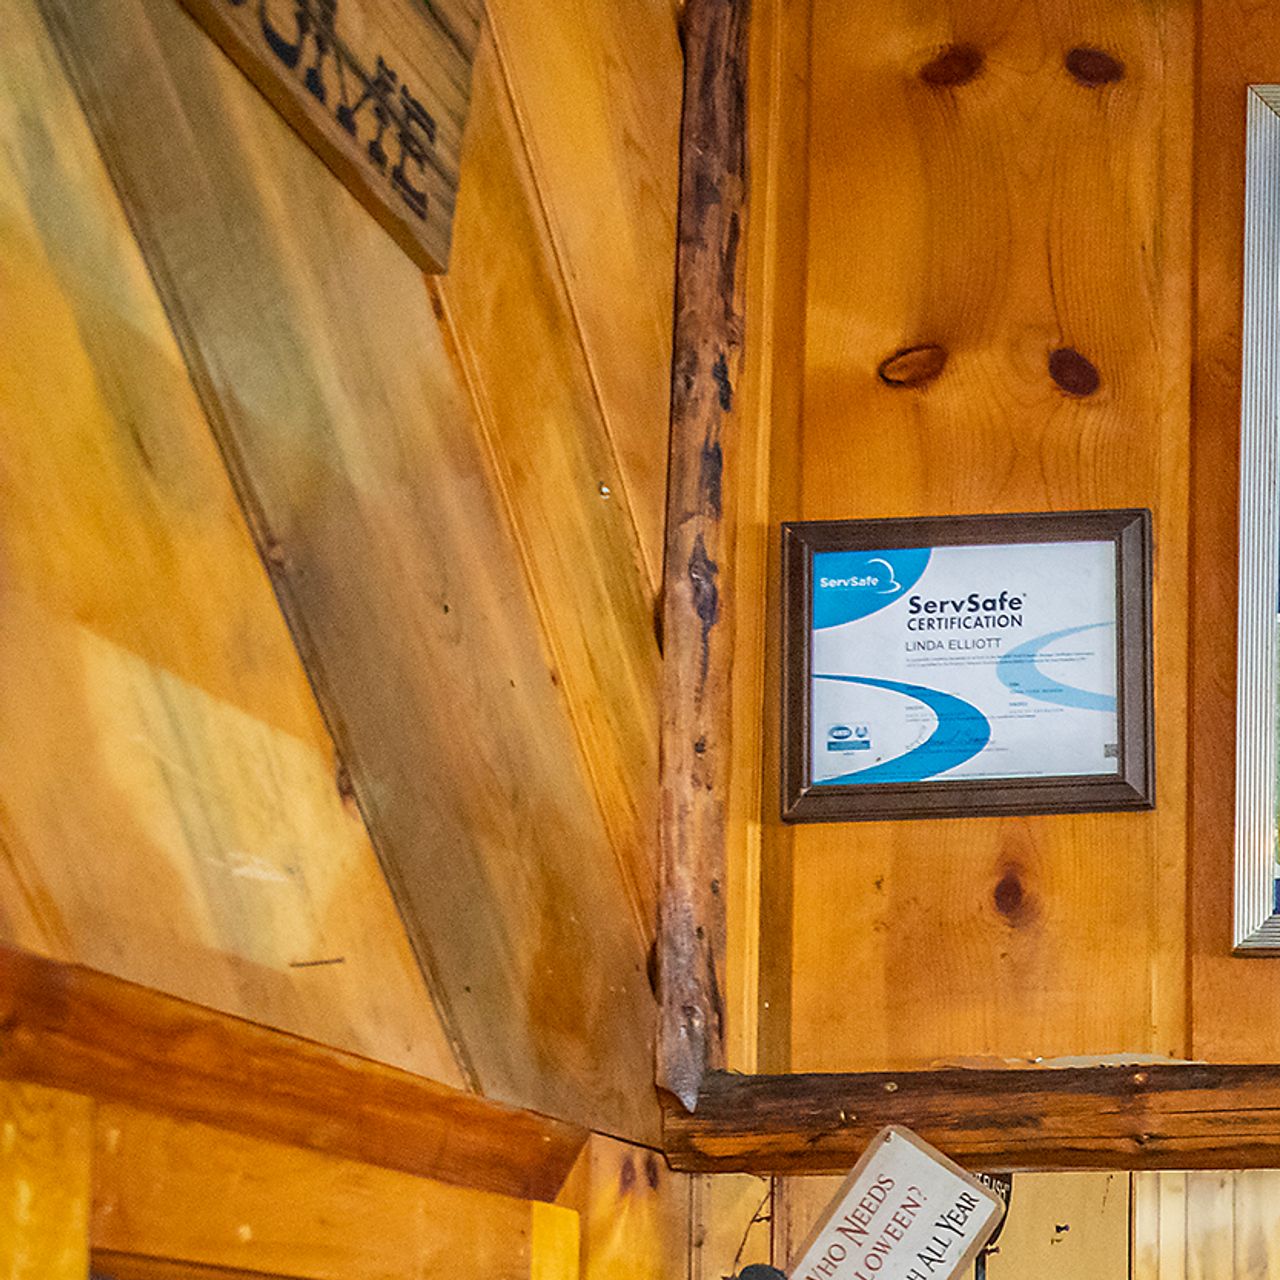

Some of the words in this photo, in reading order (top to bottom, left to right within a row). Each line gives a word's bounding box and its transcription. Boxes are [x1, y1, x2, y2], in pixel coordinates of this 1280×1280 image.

[820, 576, 879, 589] ServSafe
[908, 592, 1023, 614] ServSafe
[907, 614, 1023, 631] CERTIFICATION
[905, 639, 944, 652] LINDA
[948, 637, 1002, 651] ELLIOTT
[836, 1173, 897, 1247] NEEDS
[916, 1236, 952, 1273] ALL
[934, 1191, 980, 1238] YEAR
